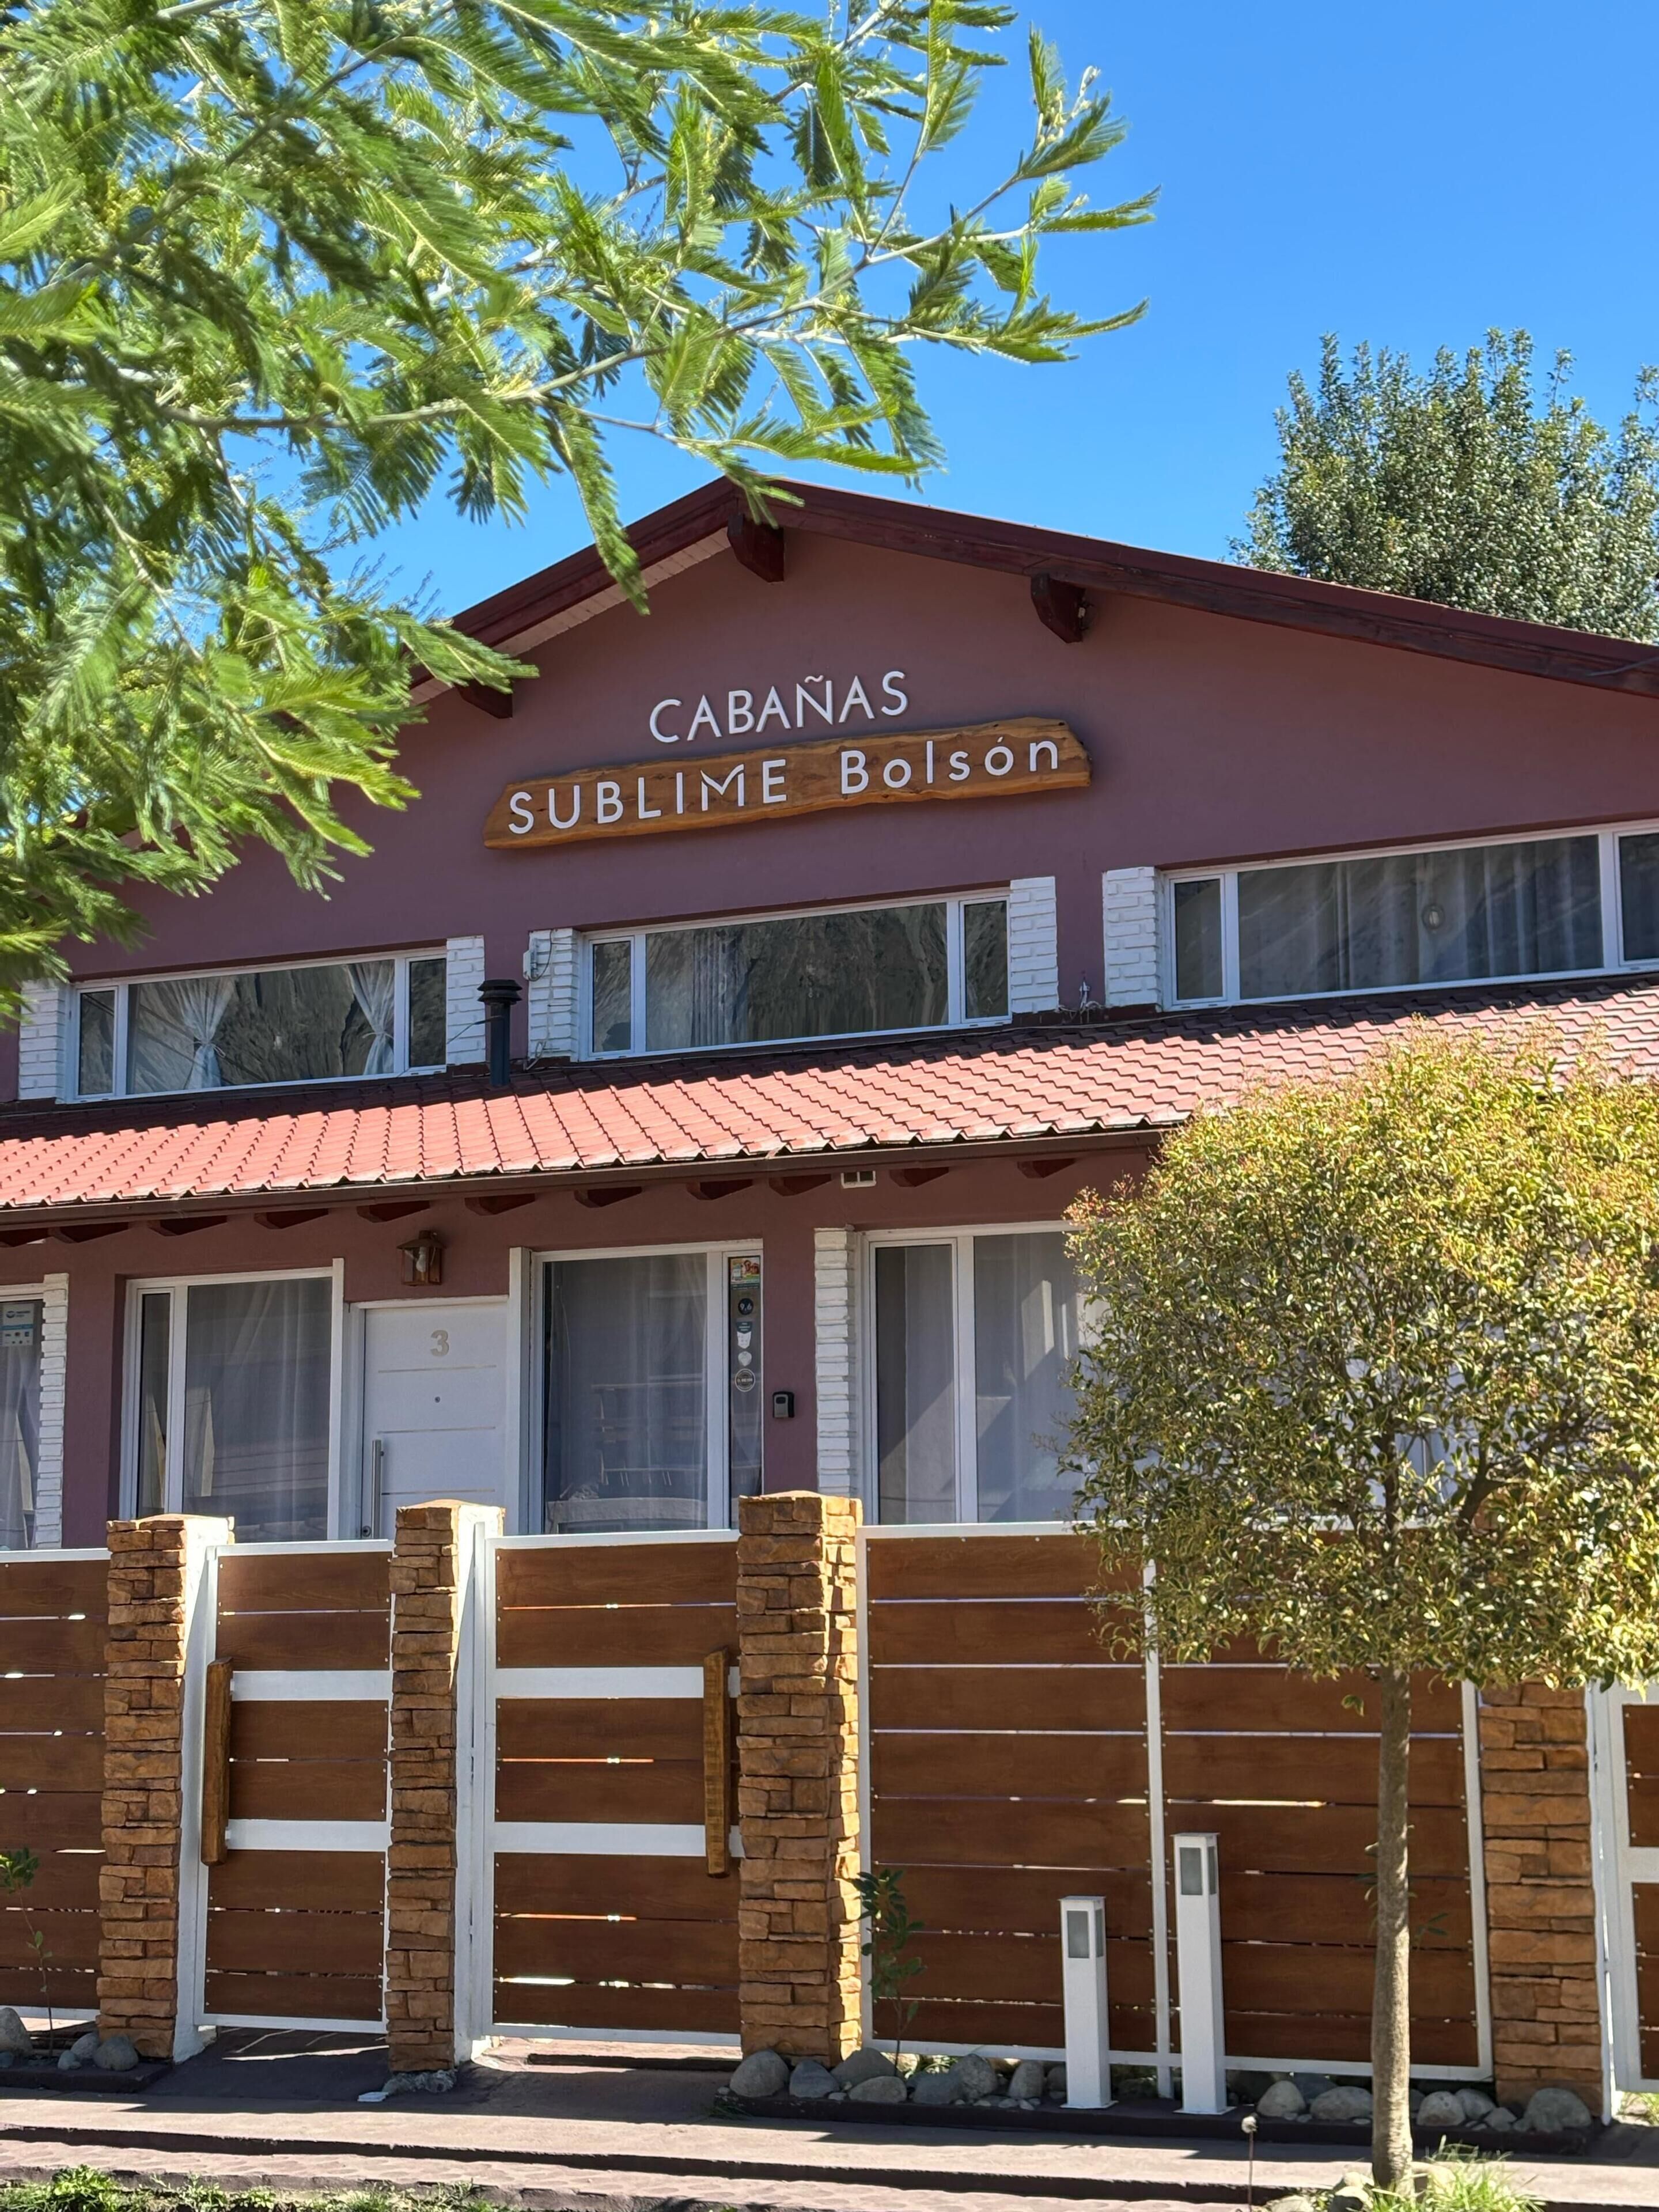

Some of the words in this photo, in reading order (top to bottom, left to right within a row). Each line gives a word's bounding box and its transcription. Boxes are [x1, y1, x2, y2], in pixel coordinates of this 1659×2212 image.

[649, 671, 907, 743] CABAÑAS
[509, 759, 787, 834] SUBLIME
[841, 736, 1058, 794] Bolsón
[430, 1330, 450, 1357] 3
